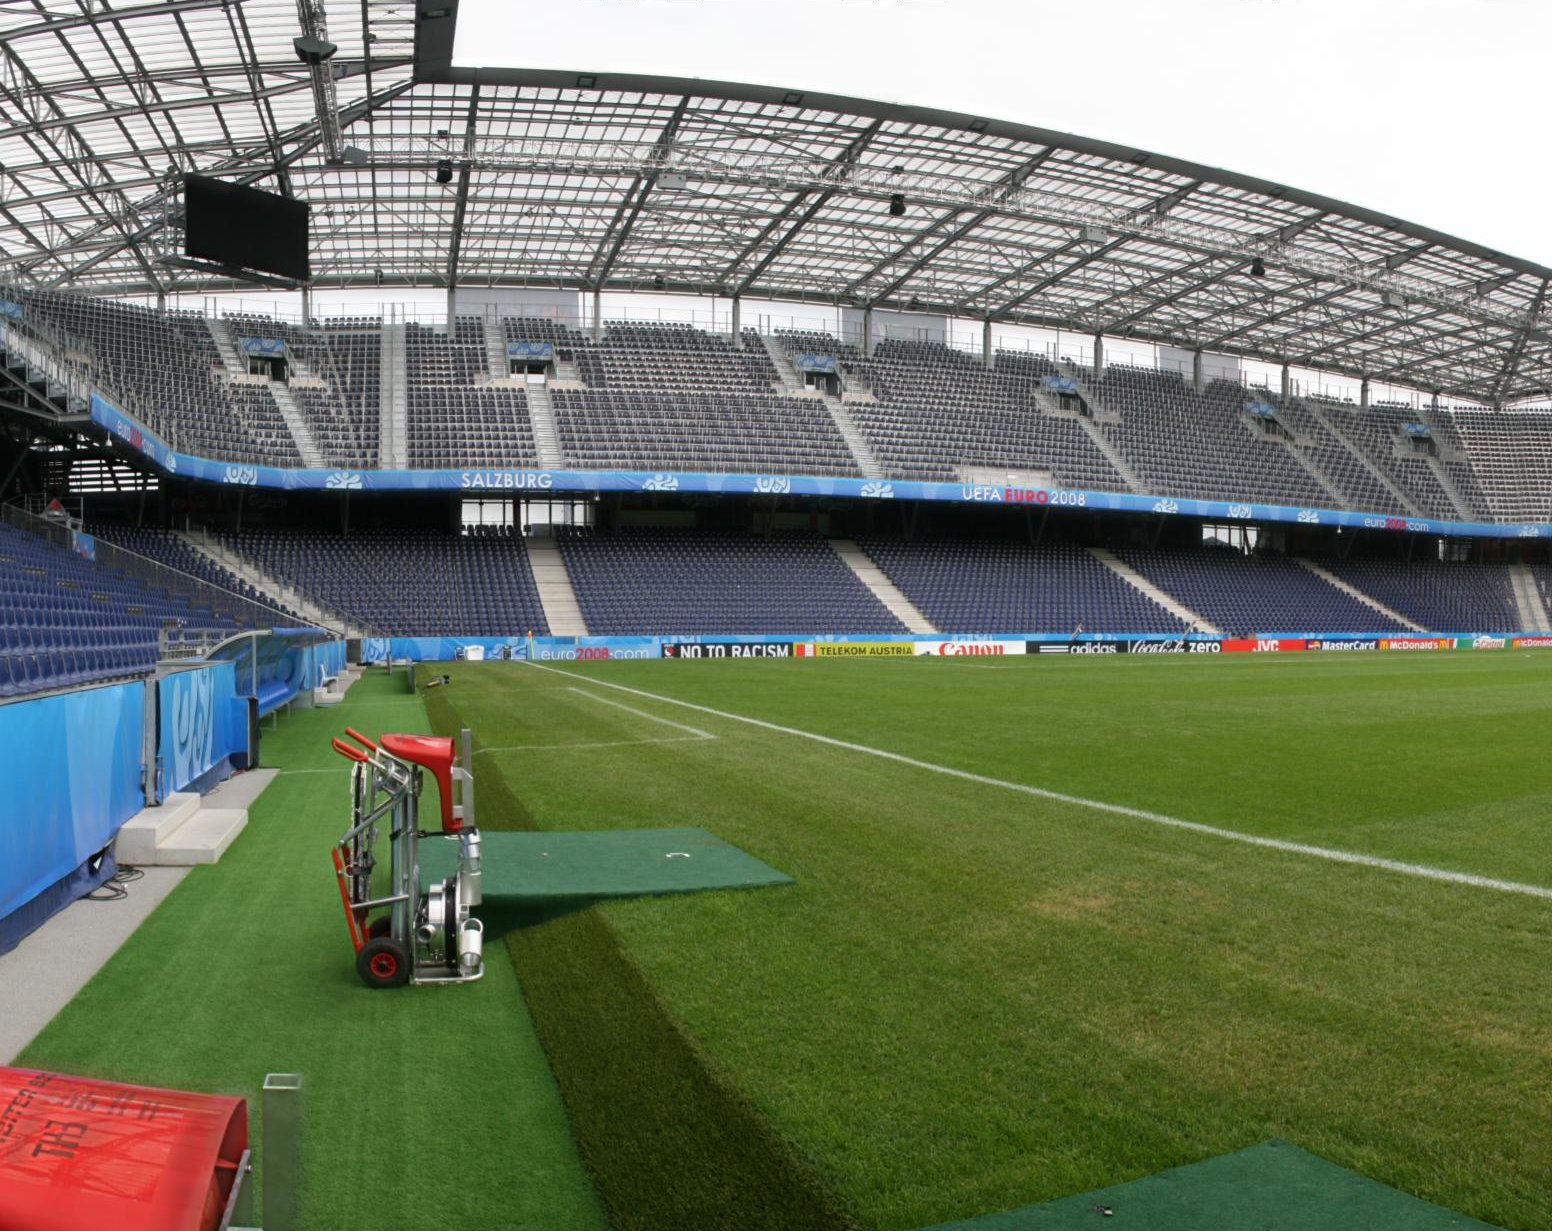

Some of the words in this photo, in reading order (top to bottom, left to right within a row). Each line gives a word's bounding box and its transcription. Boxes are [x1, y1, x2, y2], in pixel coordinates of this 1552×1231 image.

[461, 472, 553, 488] SALZBURG
[962, 487, 1002, 501] UEFA
[1004, 488, 1049, 504] EURO
[1050, 491, 1086, 507] 2008
[680, 644, 702, 657] NO
[705, 644, 728, 657] TO
[731, 644, 789, 657] RACISM
[820, 646, 867, 656] TELEKOM
[869, 646, 913, 655] AUSTRIA
[938, 642, 1004, 655] Canon
[1070, 642, 1117, 654] adidas
[1189, 641, 1221, 653] zero
[1251, 640, 1280, 652] JVC
[1321, 641, 1376, 650] MasterCard
[1389, 641, 1439, 650] McDonald's
